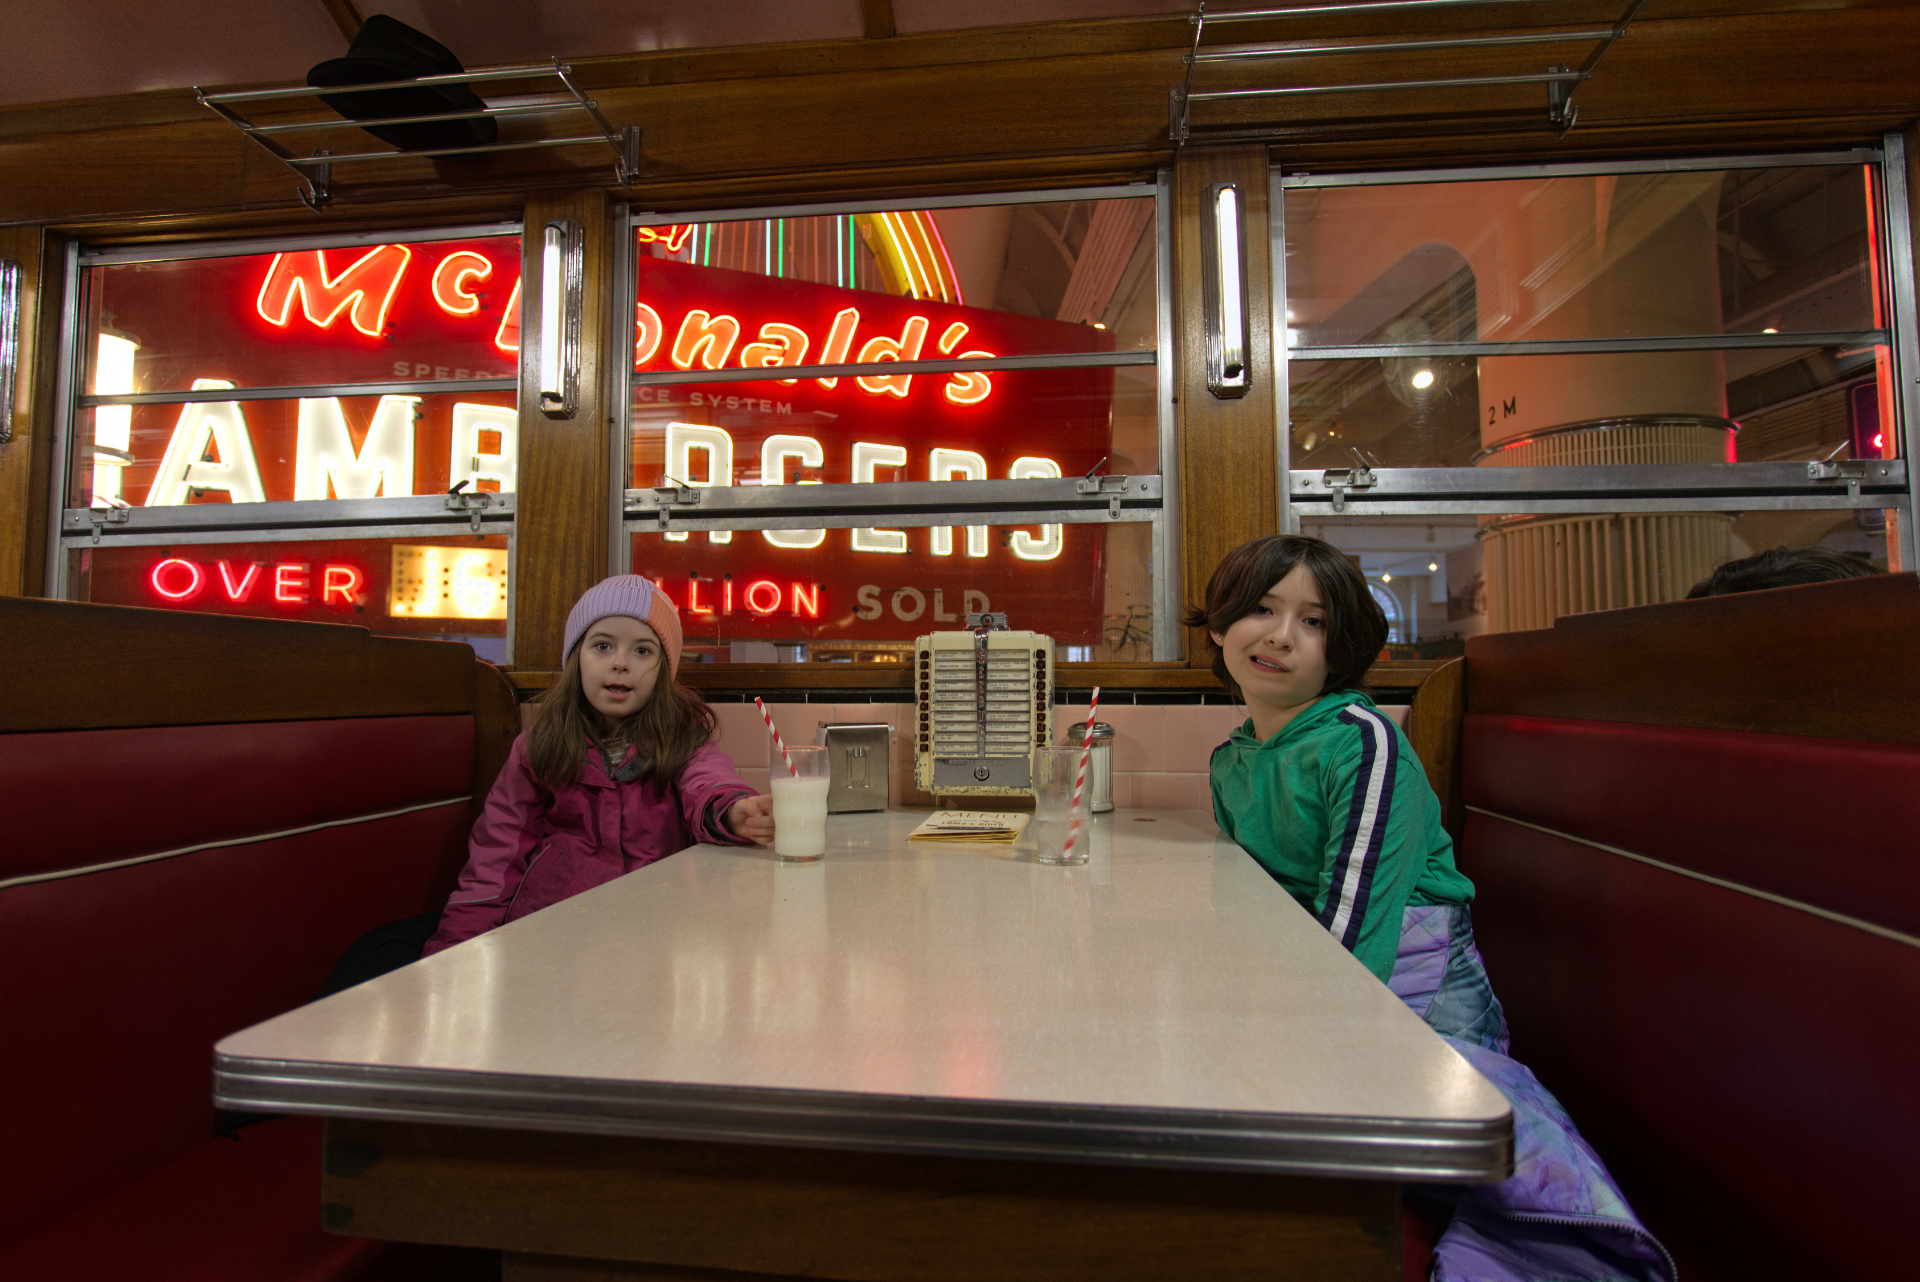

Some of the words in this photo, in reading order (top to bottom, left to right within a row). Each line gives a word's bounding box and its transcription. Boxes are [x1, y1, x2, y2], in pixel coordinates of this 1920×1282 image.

[690, 392, 792, 415] SYSTEM
[151, 557, 364, 605] OVER
[857, 584, 991, 623] SOLD
[940, 811, 1018, 819] MENU
